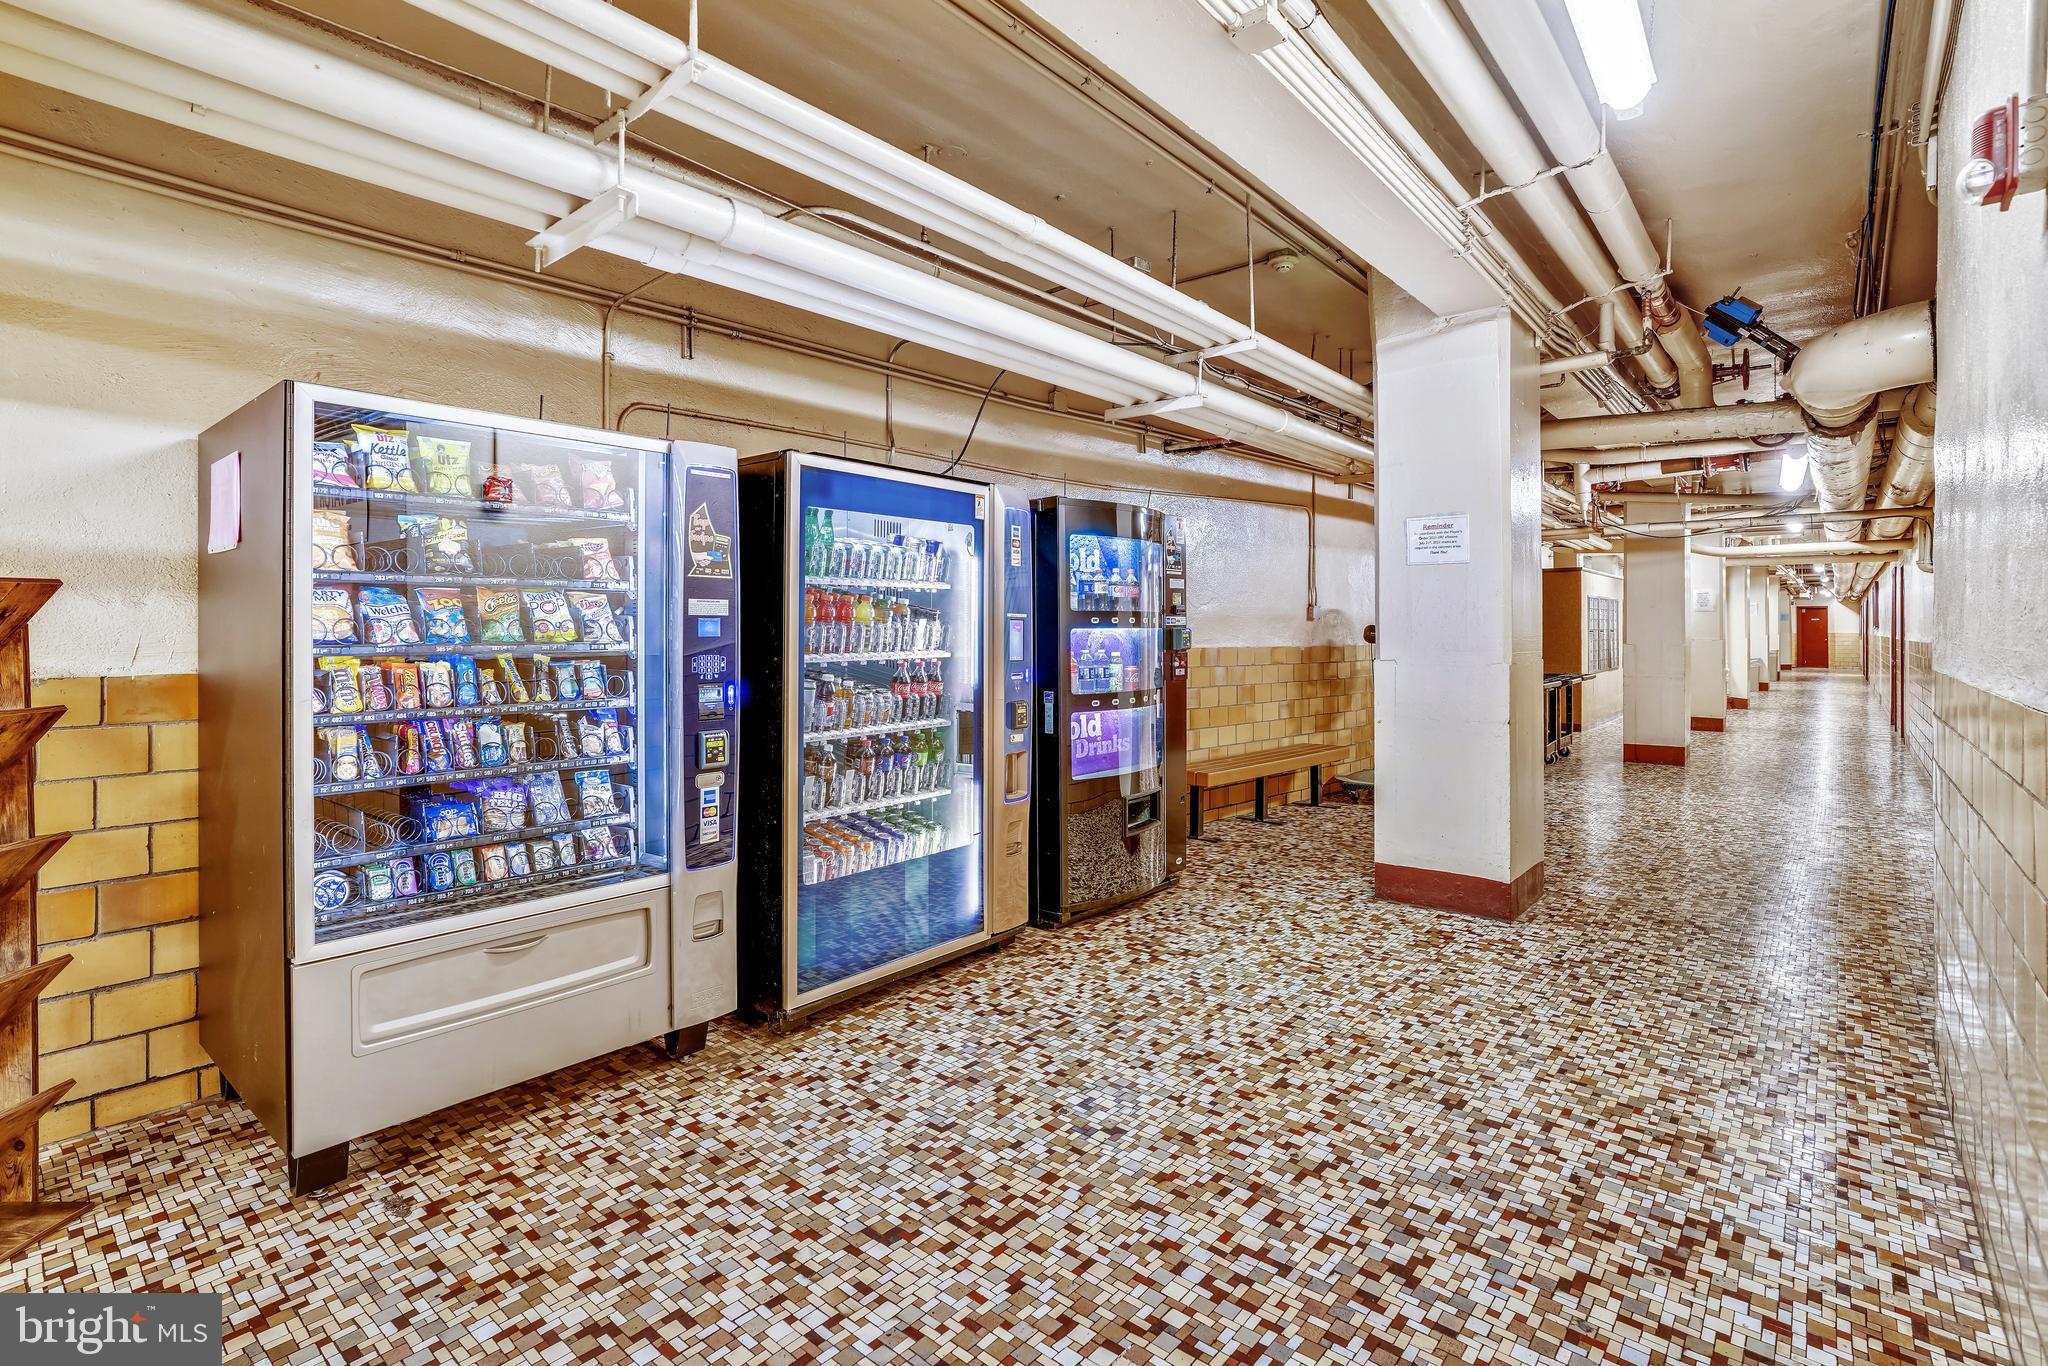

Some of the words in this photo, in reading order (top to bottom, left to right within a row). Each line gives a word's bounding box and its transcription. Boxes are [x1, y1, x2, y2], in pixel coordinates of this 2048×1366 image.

[370, 443, 408, 458] Kettle
[484, 592, 518, 613] Cheetos
[526, 590, 560, 602] SKINN
[370, 604, 410, 616] Welch's
[529, 597, 566, 615] POP
[1076, 734, 1130, 759] Drinks
[493, 791, 524, 802] BIG
[703, 819, 717, 827] VISA
